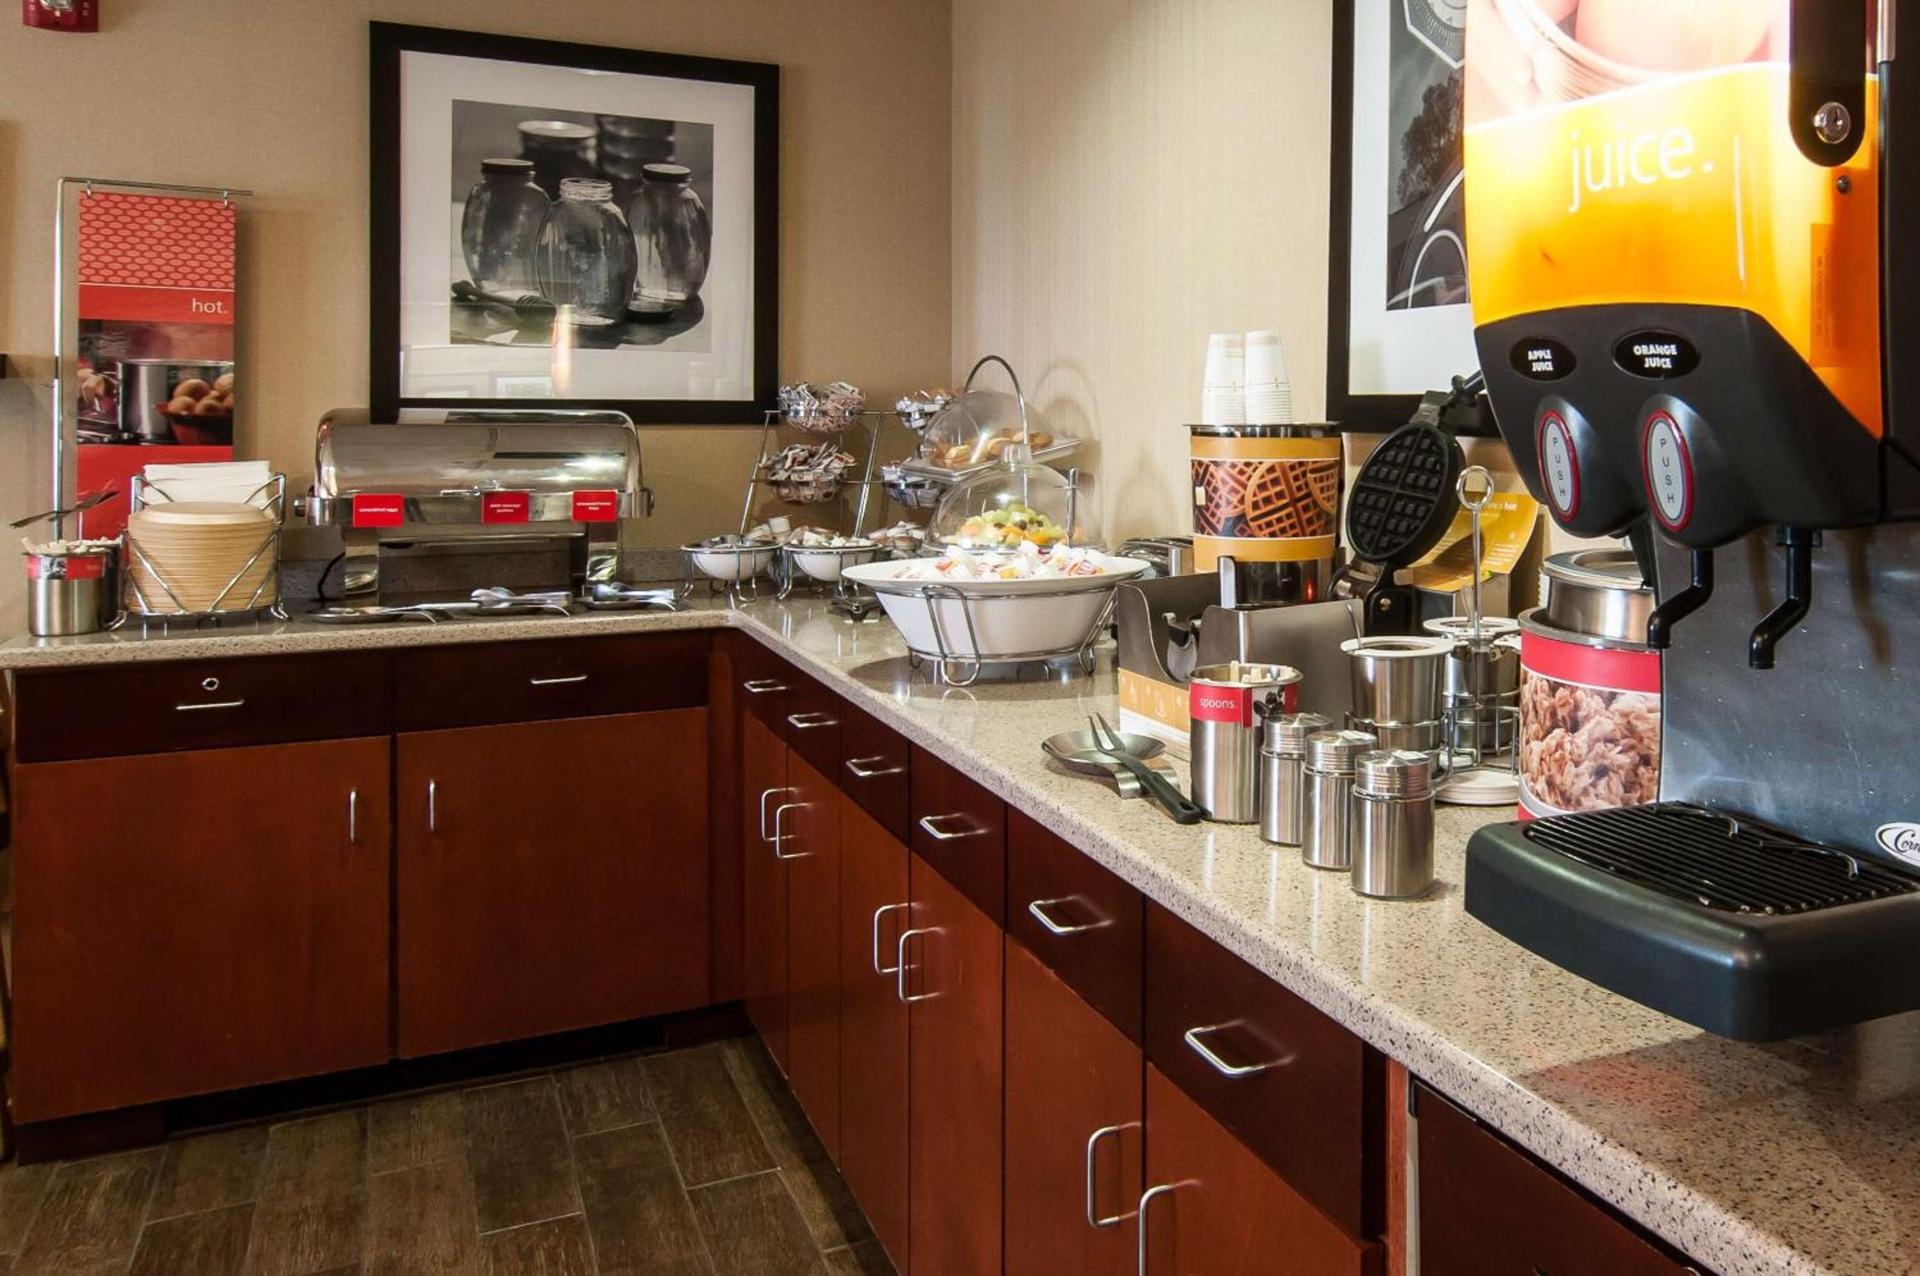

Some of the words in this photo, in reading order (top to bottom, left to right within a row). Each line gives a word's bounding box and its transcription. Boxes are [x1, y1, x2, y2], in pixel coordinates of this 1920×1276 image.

[1568, 121, 1714, 214] juice.
[192, 298, 228, 314] hot.
[1528, 349, 1552, 360] APPLE
[1633, 344, 1677, 355] ORANGE
[1532, 361, 1554, 372] JUICE
[1644, 357, 1672, 368] JUICE
[1552, 437, 1566, 496] PUSH
[1660, 438, 1674, 503] PUSH
